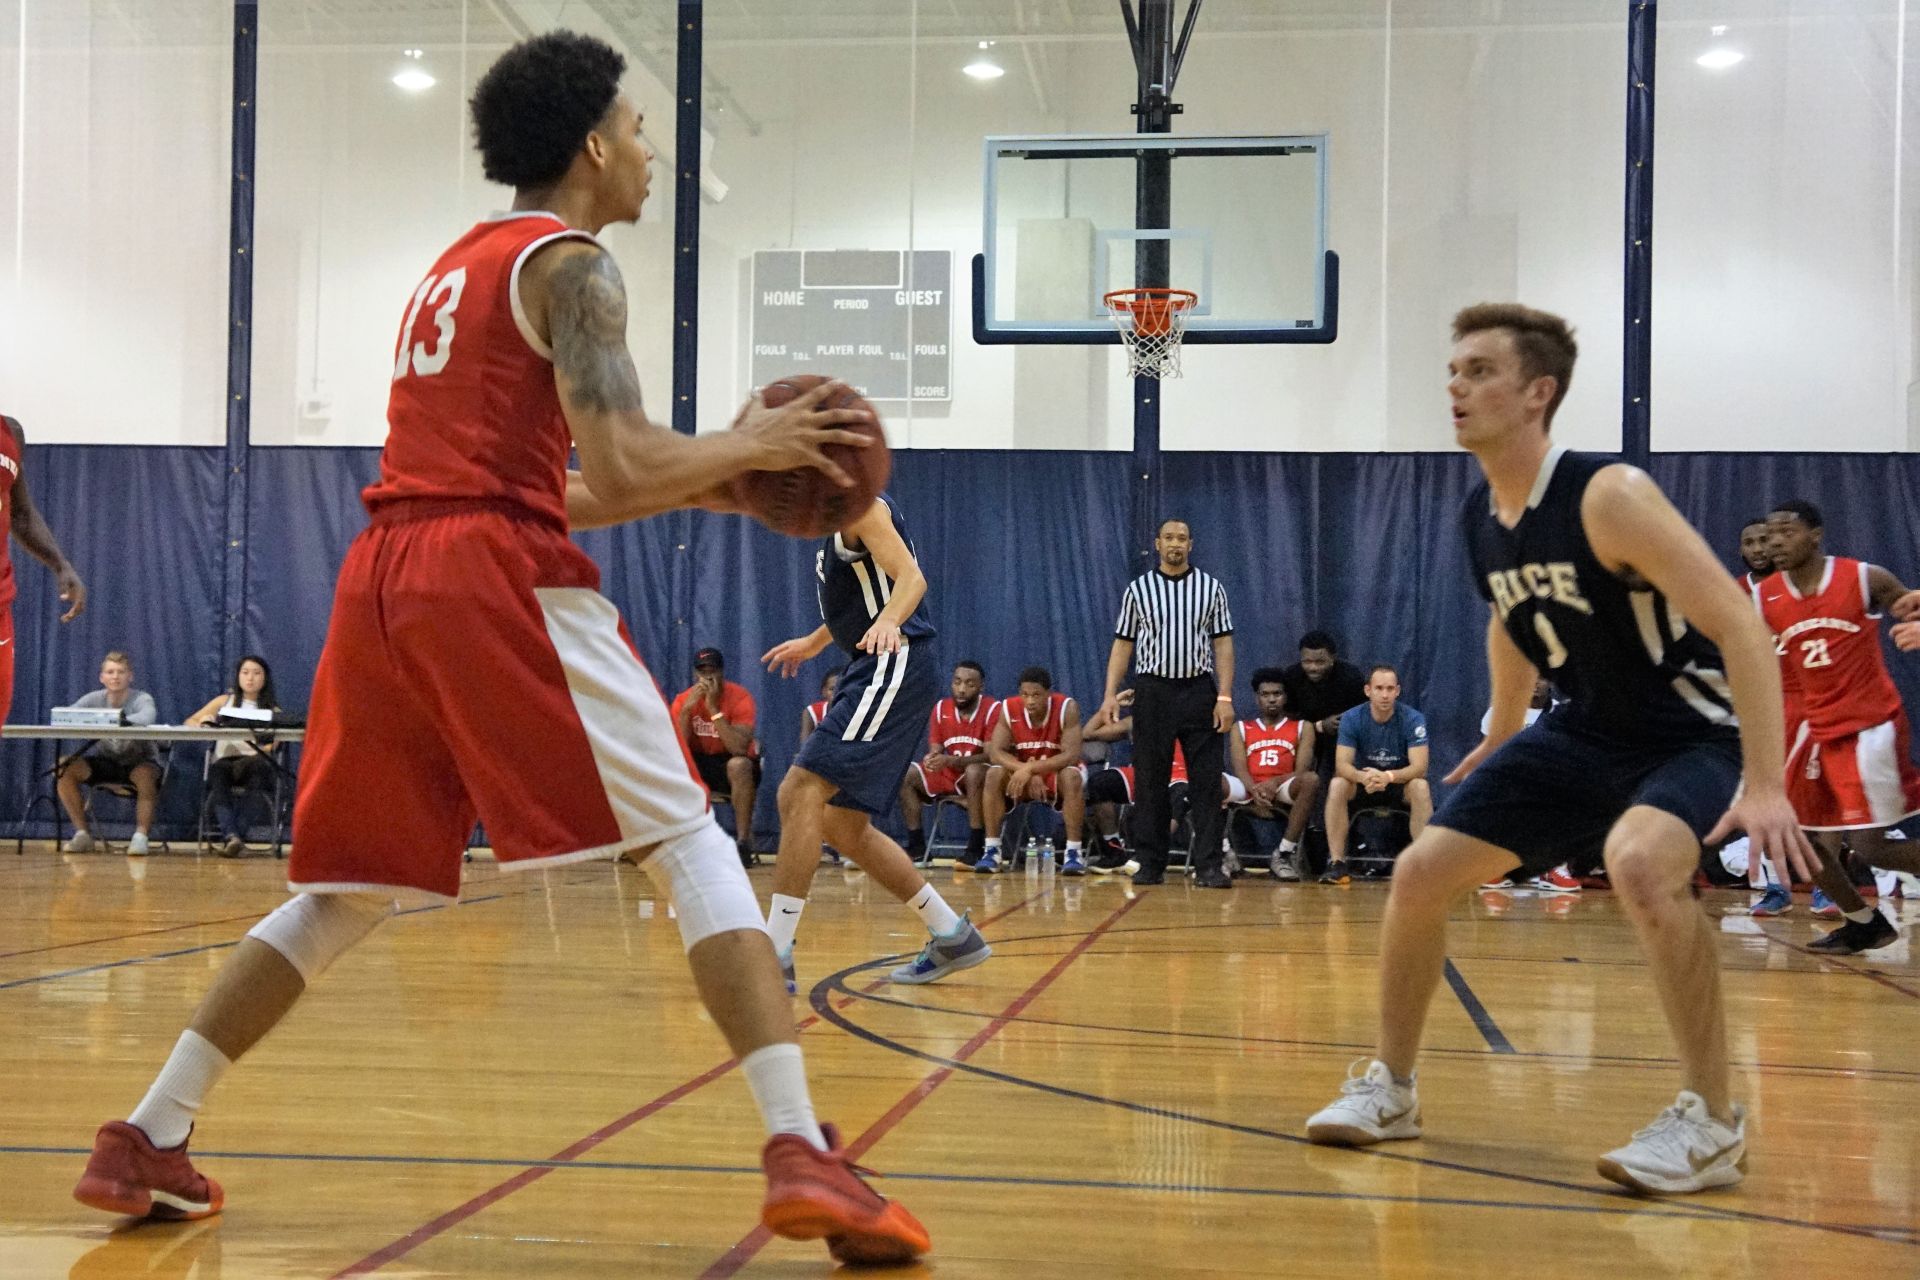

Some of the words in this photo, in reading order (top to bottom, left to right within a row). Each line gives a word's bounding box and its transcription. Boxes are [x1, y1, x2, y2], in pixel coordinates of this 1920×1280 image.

[763, 291, 805, 306] HOME
[833, 299, 869, 310] PERIOD
[894, 290, 943, 306] GUEST
[391, 266, 467, 382] 13
[755, 345, 787, 355] FOULS
[817, 345, 854, 355] PLAYER
[859, 344, 883, 355] FOUL
[915, 344, 947, 355] FOULS
[914, 386, 946, 397] SCORE
[1487, 562, 1594, 620] RICE
[1800, 638, 1832, 669] 21
[1258, 749, 1280, 767] 15
